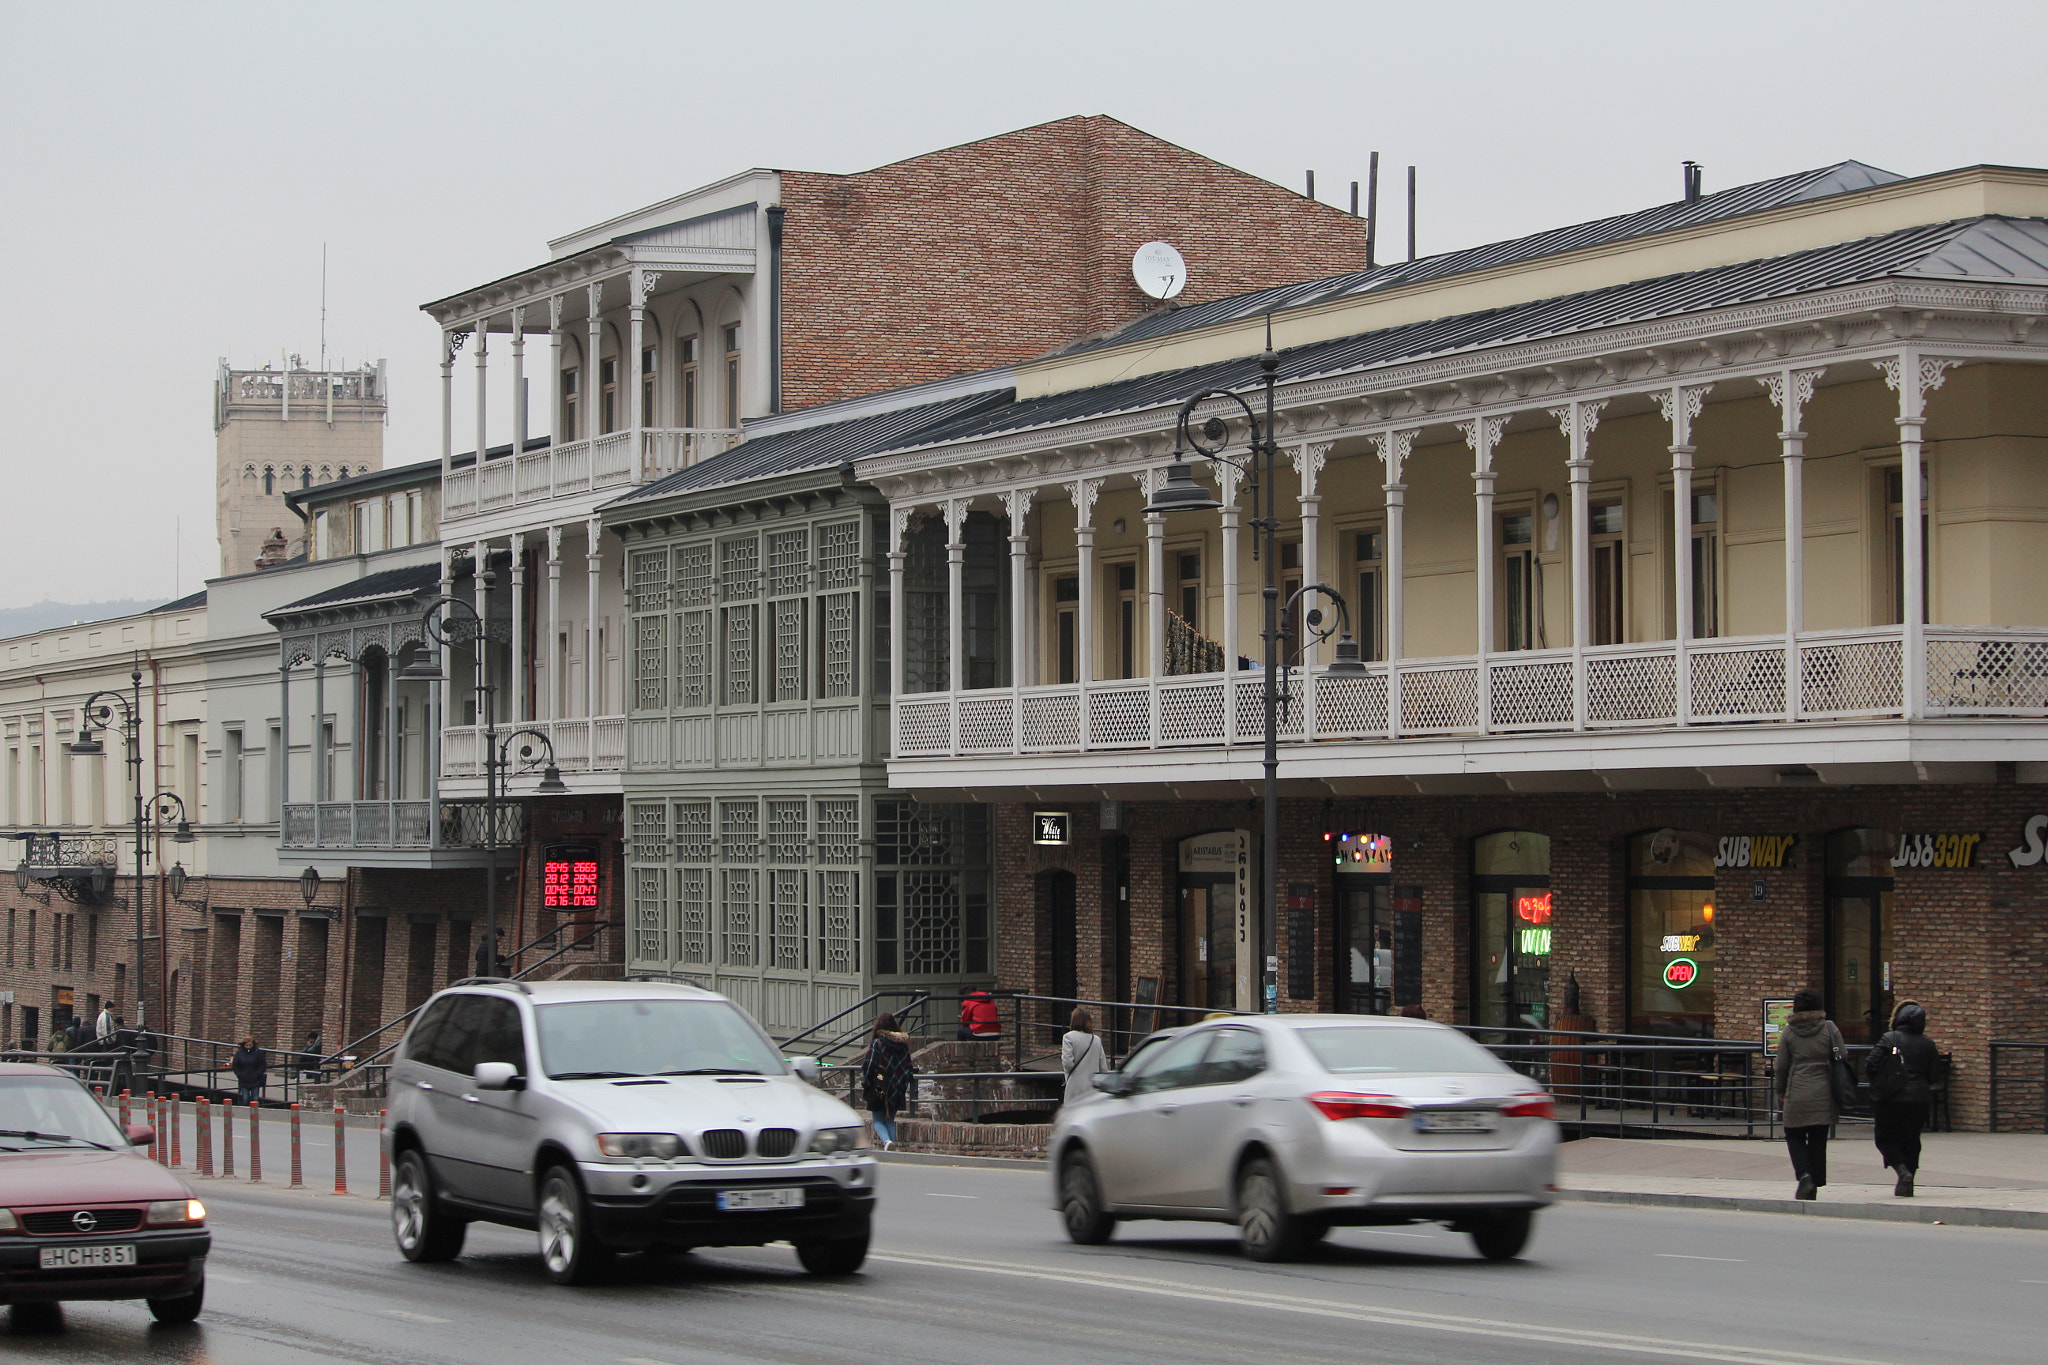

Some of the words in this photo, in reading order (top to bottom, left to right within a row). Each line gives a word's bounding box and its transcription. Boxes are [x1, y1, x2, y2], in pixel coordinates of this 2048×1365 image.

[2008, 814, 2048, 869] S
[1193, 846, 1222, 856] ARISTAEUS
[1713, 835, 1794, 868] SUBWAY
[1754, 884, 1763, 896] 19
[1660, 934, 1700, 952] SUBWAY
[1667, 965, 1693, 981] OPEN
[53, 1246, 133, 1265] HCH-851
